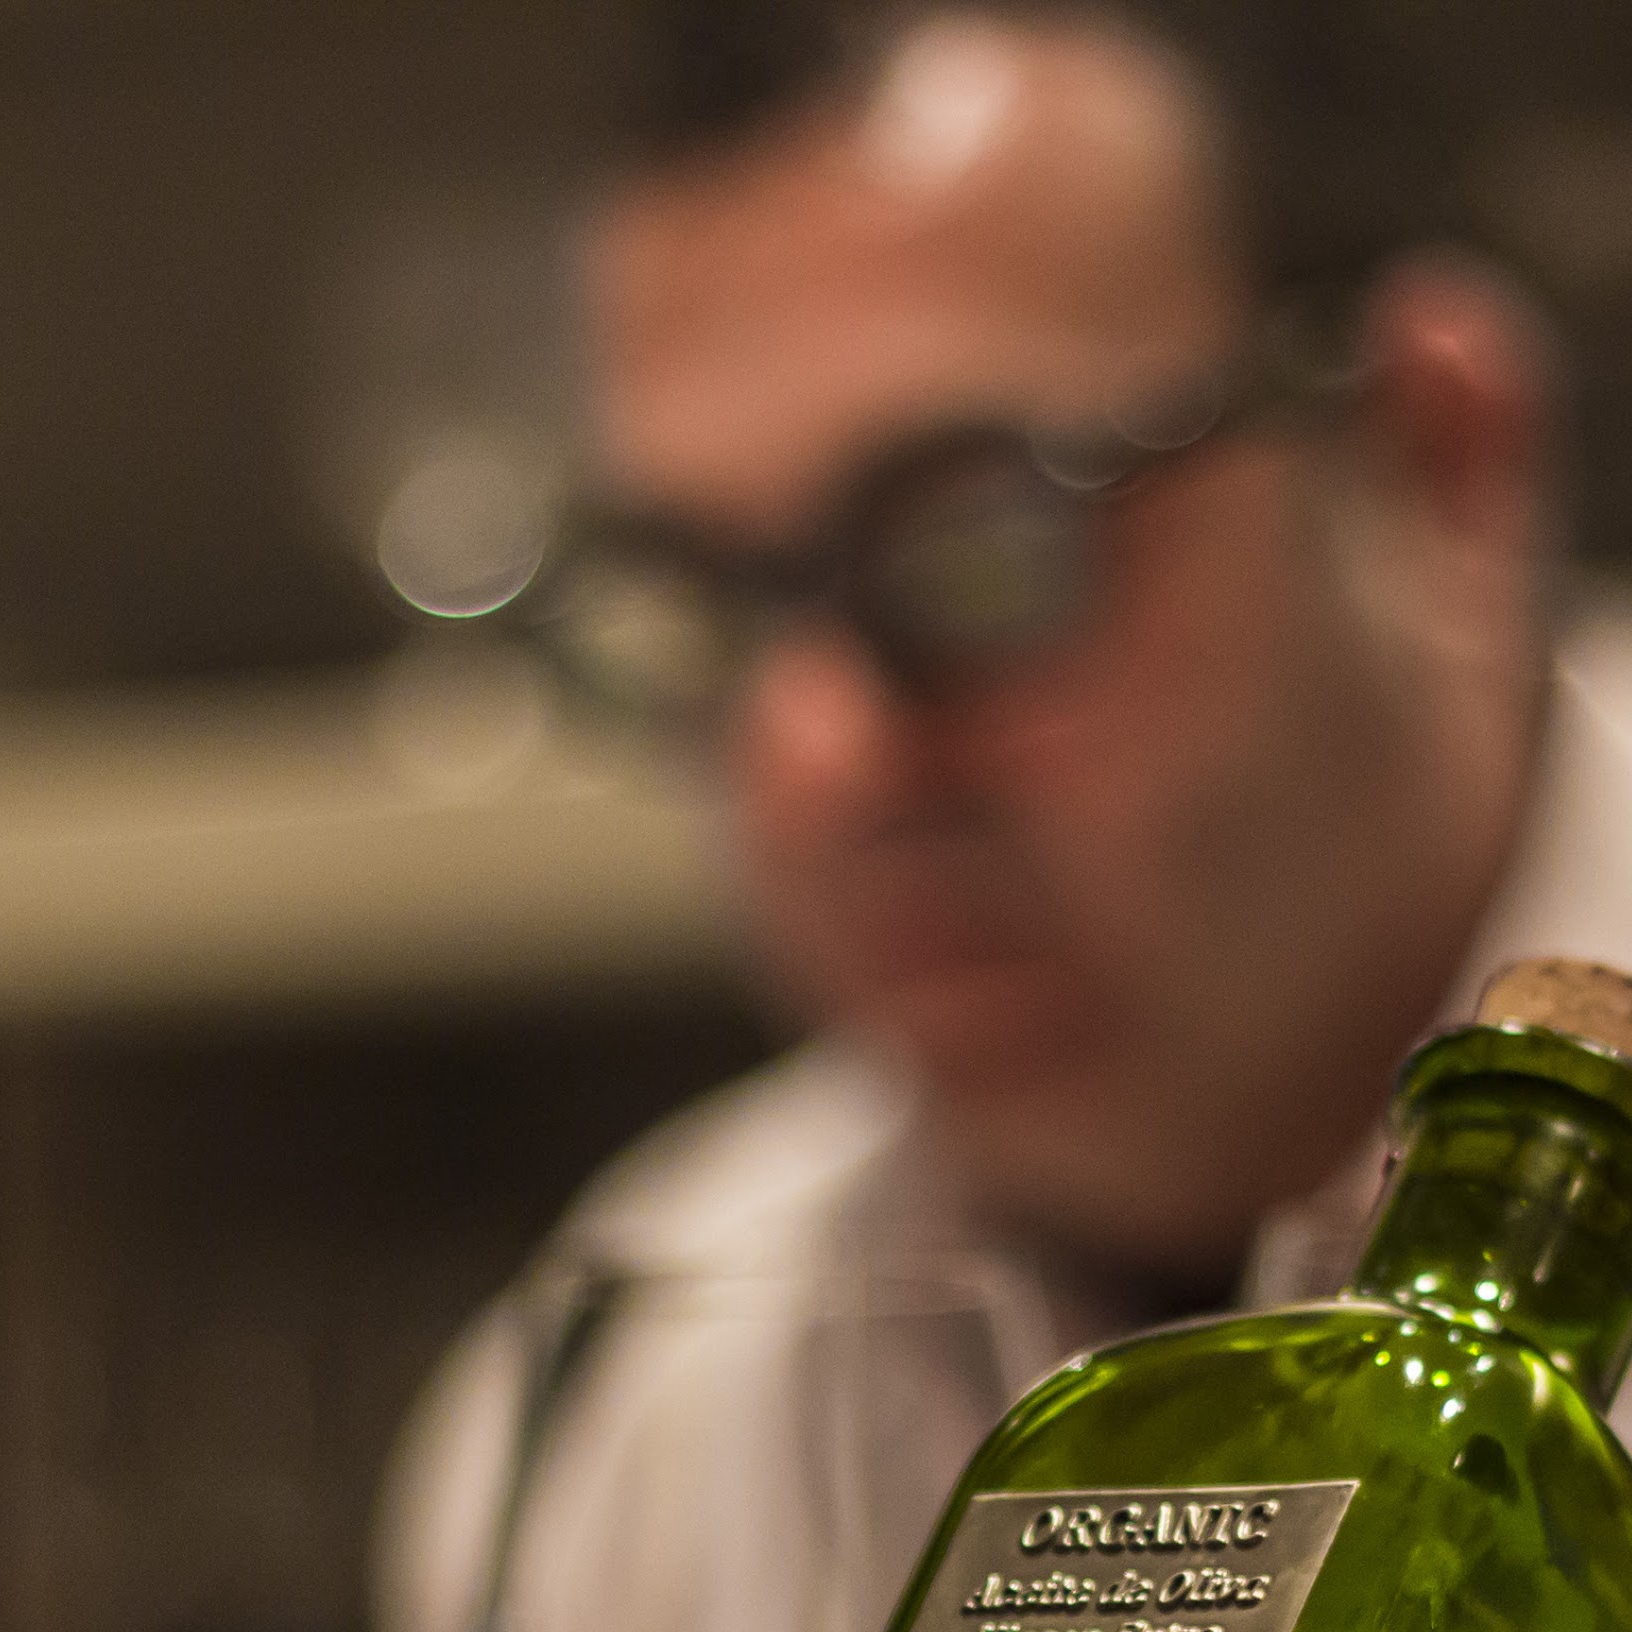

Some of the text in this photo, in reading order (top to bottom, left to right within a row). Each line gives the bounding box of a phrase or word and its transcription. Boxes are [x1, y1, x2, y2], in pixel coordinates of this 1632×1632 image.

[1022, 1500, 1279, 1551] ORGANIC
[965, 1568, 1271, 1612] Aceite de Oliva
